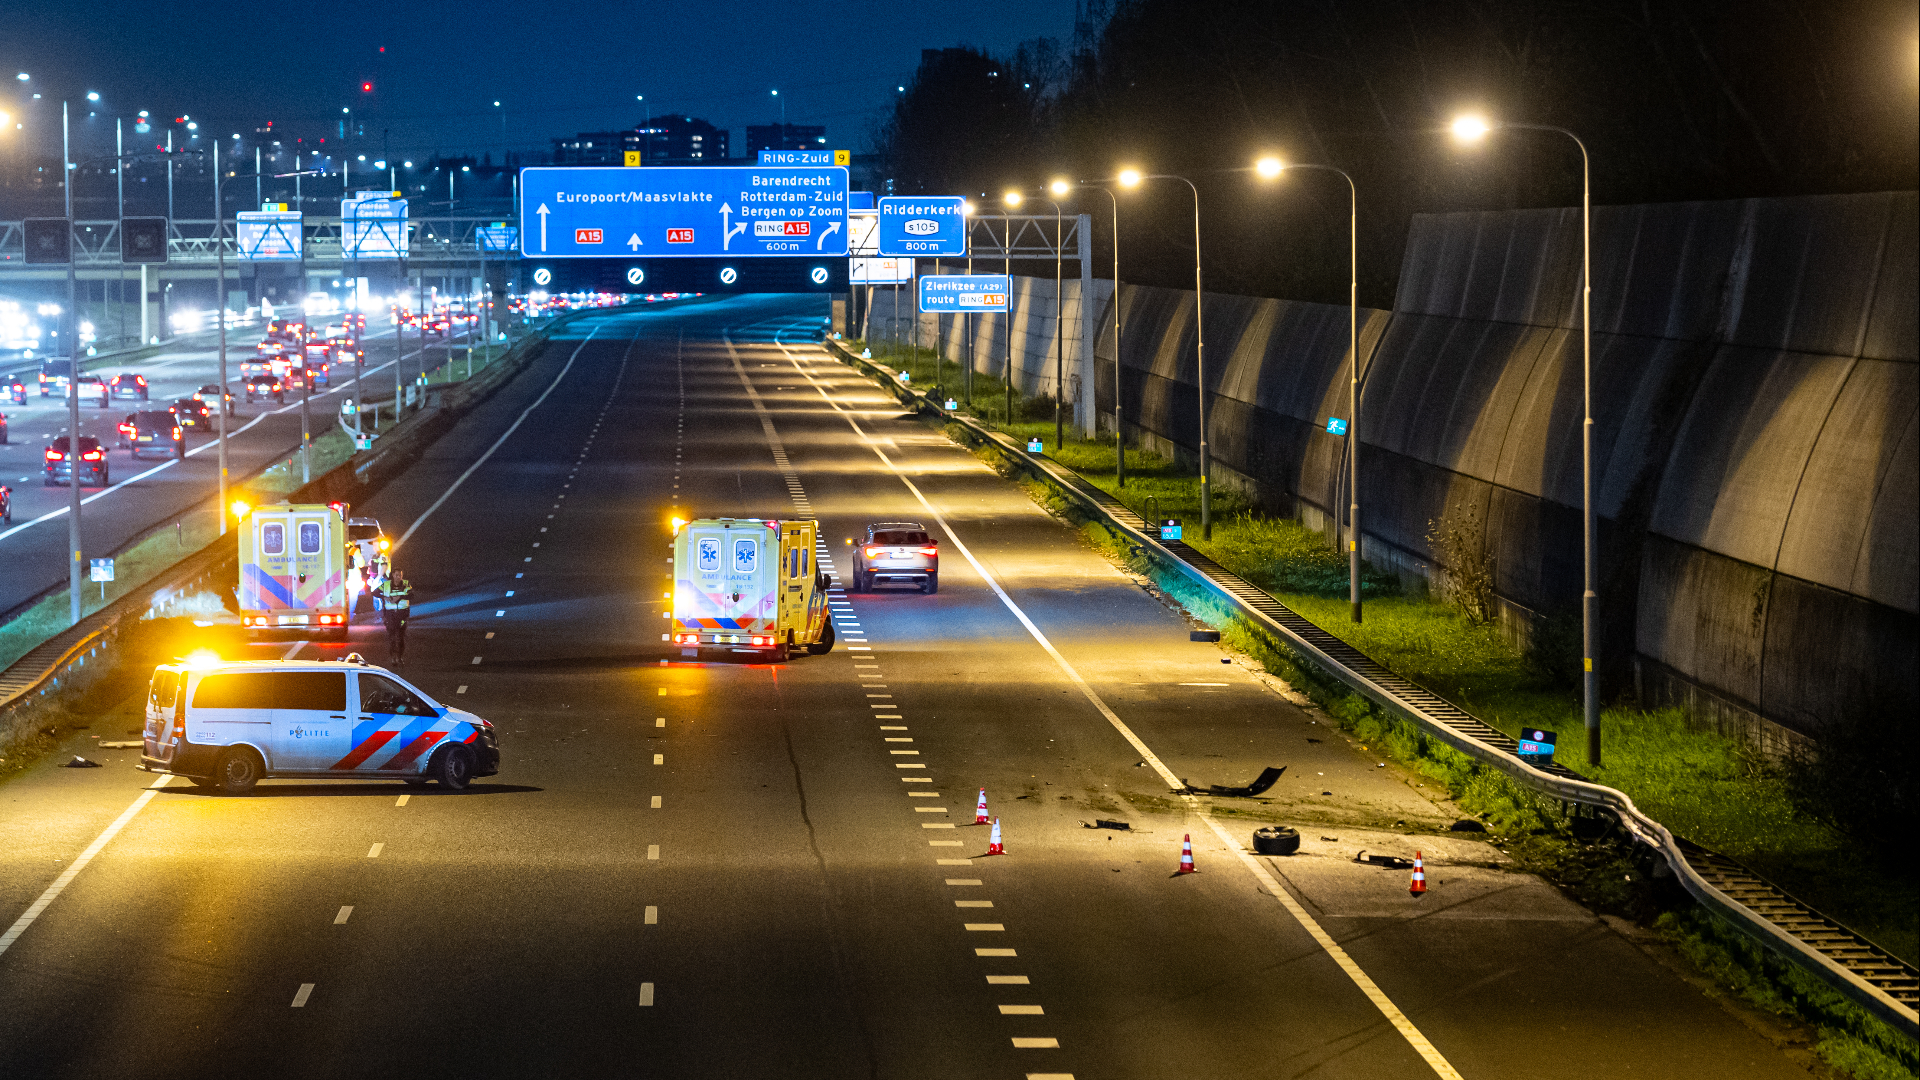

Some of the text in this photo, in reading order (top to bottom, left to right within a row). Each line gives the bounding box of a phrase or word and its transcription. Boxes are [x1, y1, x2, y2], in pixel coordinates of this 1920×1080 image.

[629, 155, 636, 163] 9
[763, 154, 829, 163] RING-Zuid
[838, 154, 845, 163] 9
[752, 176, 831, 186] Barendrecht
[556, 191, 713, 204] Europoort/Maasvlakte
[741, 191, 843, 202] Rotterdam-Zuid
[741, 206, 843, 219] Bergen op Zoom
[883, 205, 961, 215] Ridderkerk
[756, 223, 808, 233] RING A15
[578, 232, 601, 241] A15
[670, 231, 693, 240] A15
[926, 282, 1003, 291] Zierikzee (A29)
[927, 295, 954, 304] route
[985, 295, 1004, 304] A15
